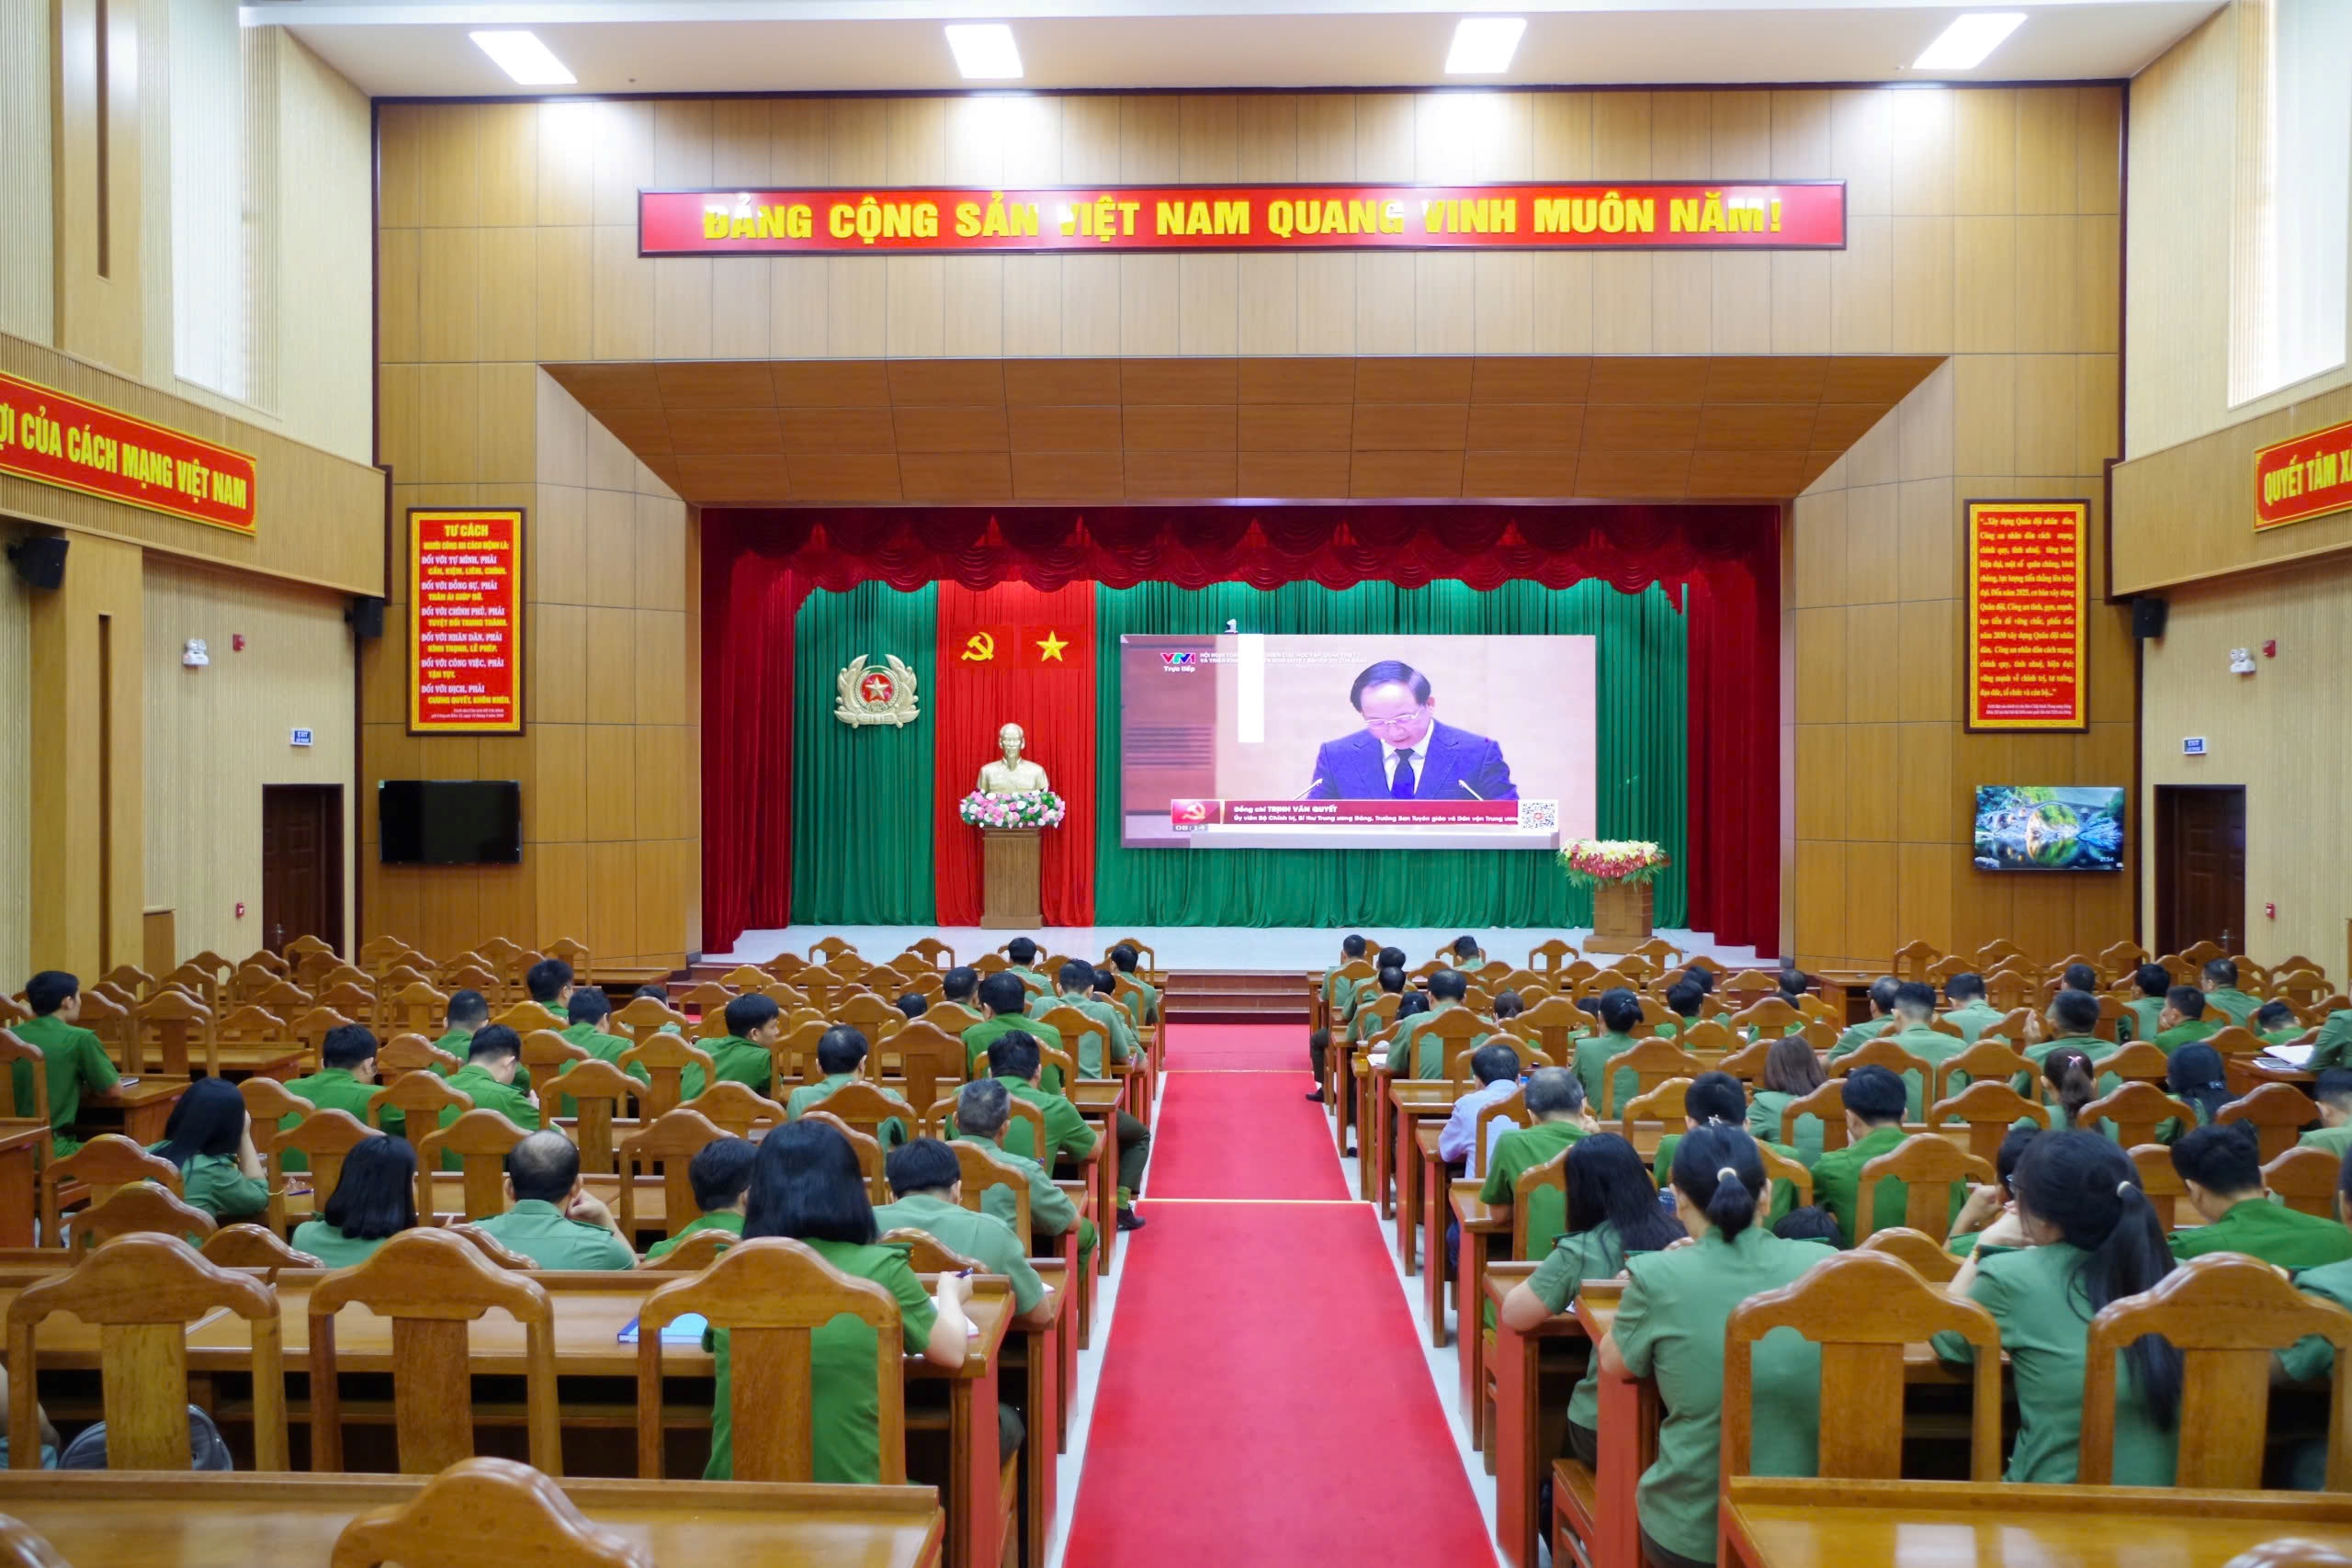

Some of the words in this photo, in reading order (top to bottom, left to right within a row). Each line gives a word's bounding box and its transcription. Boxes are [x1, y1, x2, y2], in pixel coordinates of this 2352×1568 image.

[704, 193, 812, 239] ĐẢNG
[830, 196, 939, 244] CỘNG
[956, 191, 1039, 237] SẢN
[1058, 196, 1140, 243] VIỆT
[1157, 201, 1250, 236] NAM
[1268, 197, 1405, 238] QUANG
[1422, 197, 1516, 234] VINH
[1534, 191, 1655, 233] MUÔN
[21, 405, 62, 458] CỦA
[67, 424, 118, 474] CÁCH
[122, 443, 174, 490] MẠNG
[176, 457, 209, 503] VIỆT
[212, 470, 247, 510] NAM
[2264, 454, 2304, 506] QUYẾT
[2306, 450, 2336, 492] TÂM
[460, 523, 489, 536] CÁCH
